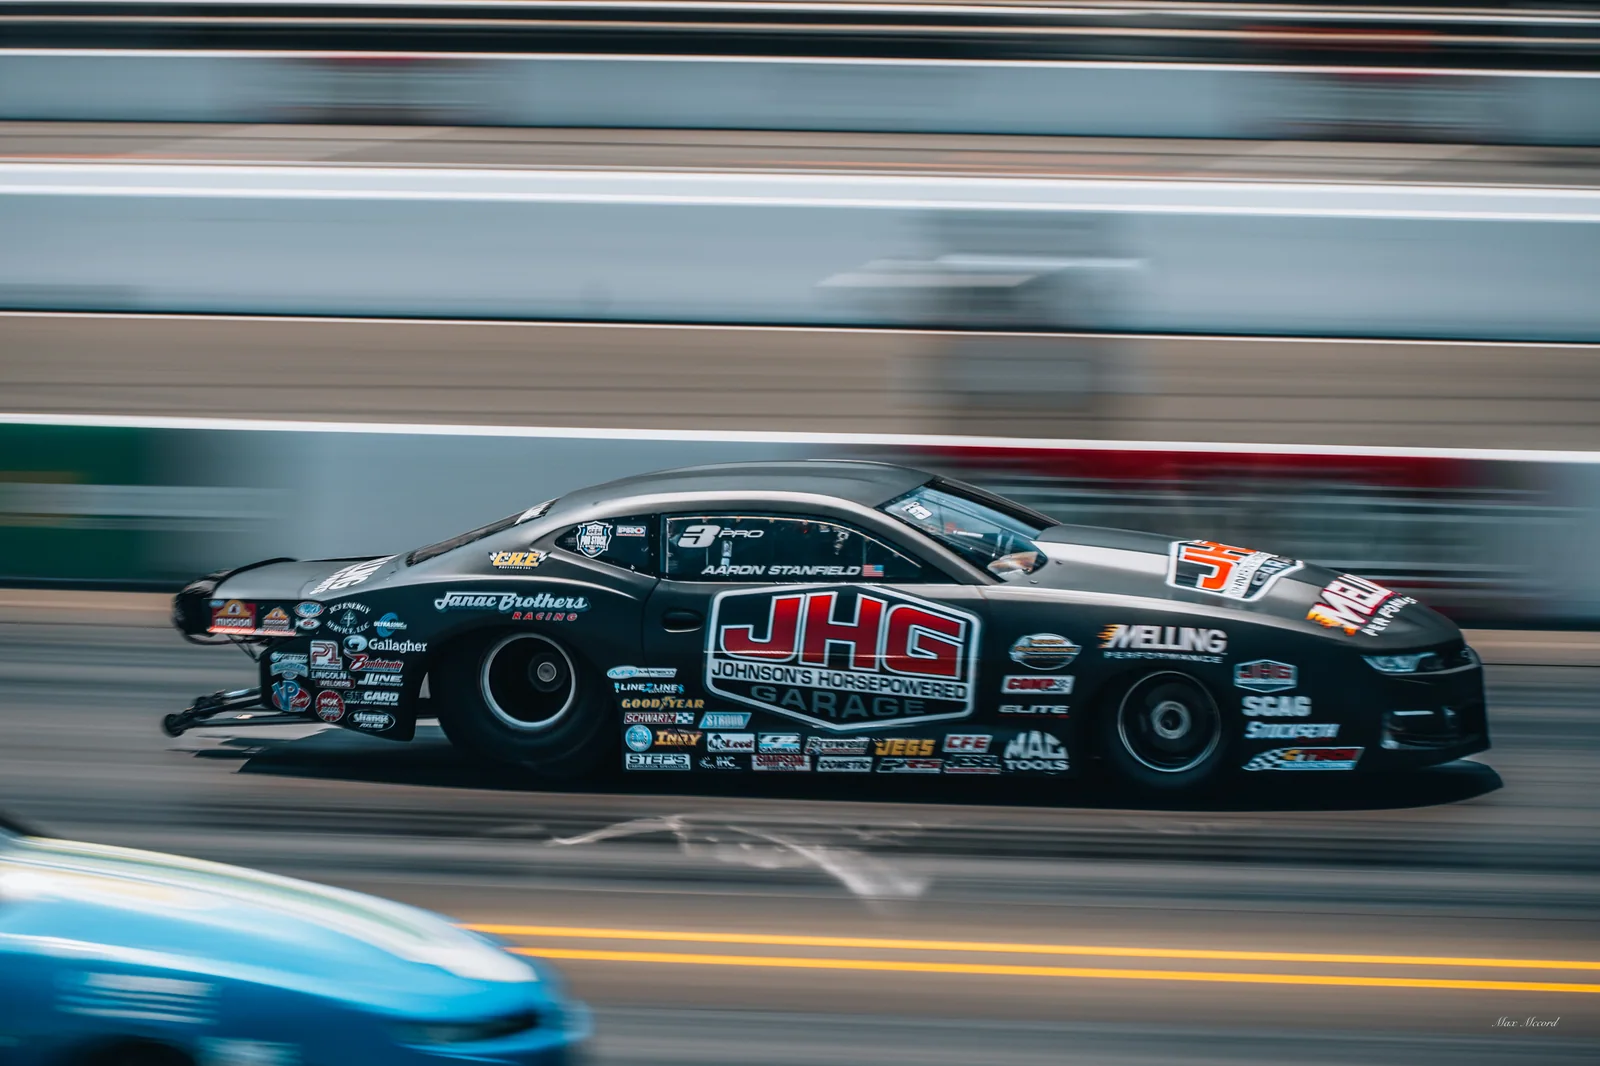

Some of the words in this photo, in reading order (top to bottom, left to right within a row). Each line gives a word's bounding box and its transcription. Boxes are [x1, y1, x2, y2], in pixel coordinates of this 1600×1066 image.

[678, 525, 721, 548] 3
[718, 529, 764, 538] PRO
[701, 565, 766, 575] AARON
[768, 565, 861, 576] STANFIELD
[341, 602, 371, 614] ENERGY
[434, 592, 497, 611] Janac
[498, 592, 588, 611] Brothers
[512, 611, 578, 621] RACING
[719, 591, 966, 680] JHG
[1104, 624, 1228, 653] MELLING
[368, 638, 428, 654] Gallagher
[1103, 651, 1224, 664] PERFORMANCE
[311, 671, 347, 680] LINCOLN
[711, 661, 813, 685] JOHNSON'S
[817, 671, 968, 700] HORSEPOWERED
[621, 696, 705, 711] GOODYEAR
[750, 685, 927, 718] GARAGE
[998, 704, 1070, 714] ELITE
[874, 740, 936, 756] JEGS
[946, 736, 988, 749] CFE
[1003, 730, 1069, 759] MAC
[1003, 759, 1070, 771] TOOLS
